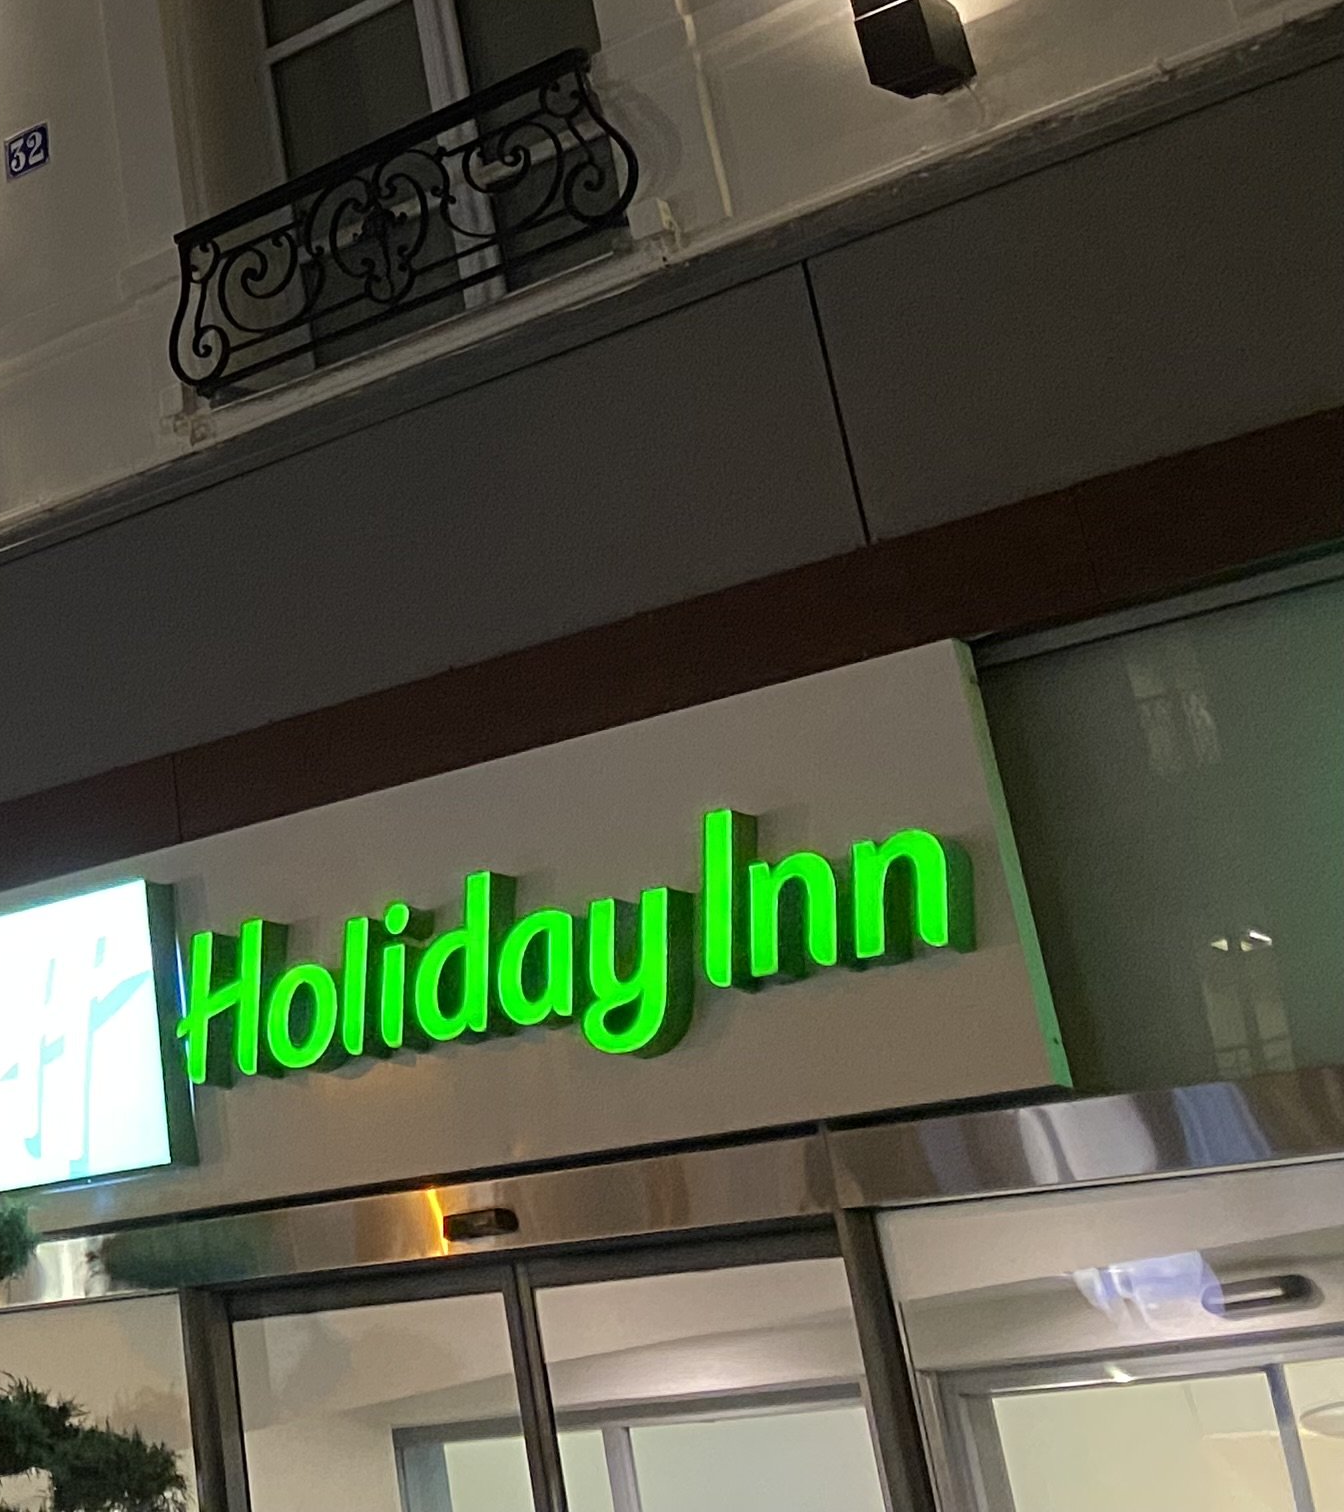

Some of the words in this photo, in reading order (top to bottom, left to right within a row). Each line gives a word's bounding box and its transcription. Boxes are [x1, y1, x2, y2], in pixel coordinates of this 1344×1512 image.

[10, 131, 45, 172] 32
[176, 870, 669, 1084] Holiday
[704, 809, 950, 989] Inn
